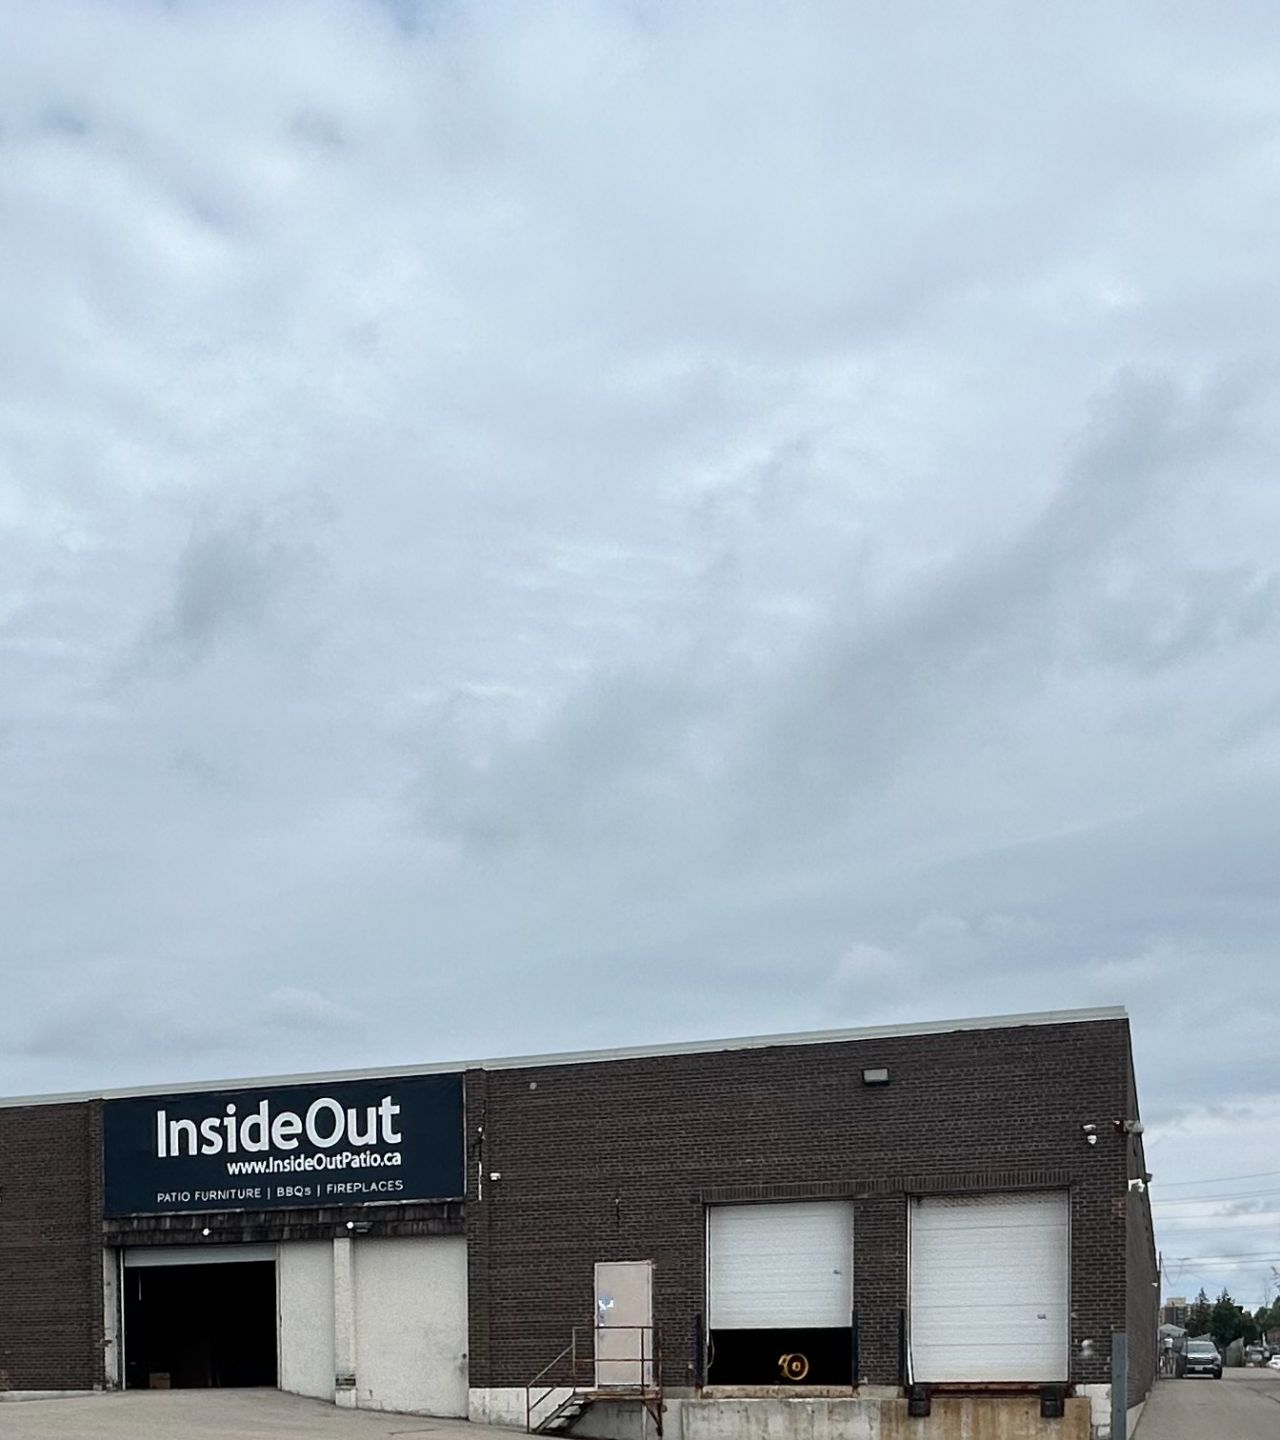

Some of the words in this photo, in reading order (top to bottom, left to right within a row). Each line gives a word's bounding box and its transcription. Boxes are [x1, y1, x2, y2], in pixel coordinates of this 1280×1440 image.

[157, 1096, 402, 1158] InsideOut
[227, 1151, 402, 1175] www.InsideOutPatio.ca
[157, 1191, 191, 1203] PATIO
[194, 1188, 261, 1201] FURNITURE
[277, 1186, 311, 1197] BBQs
[326, 1180, 403, 1194] FIREPLACES
